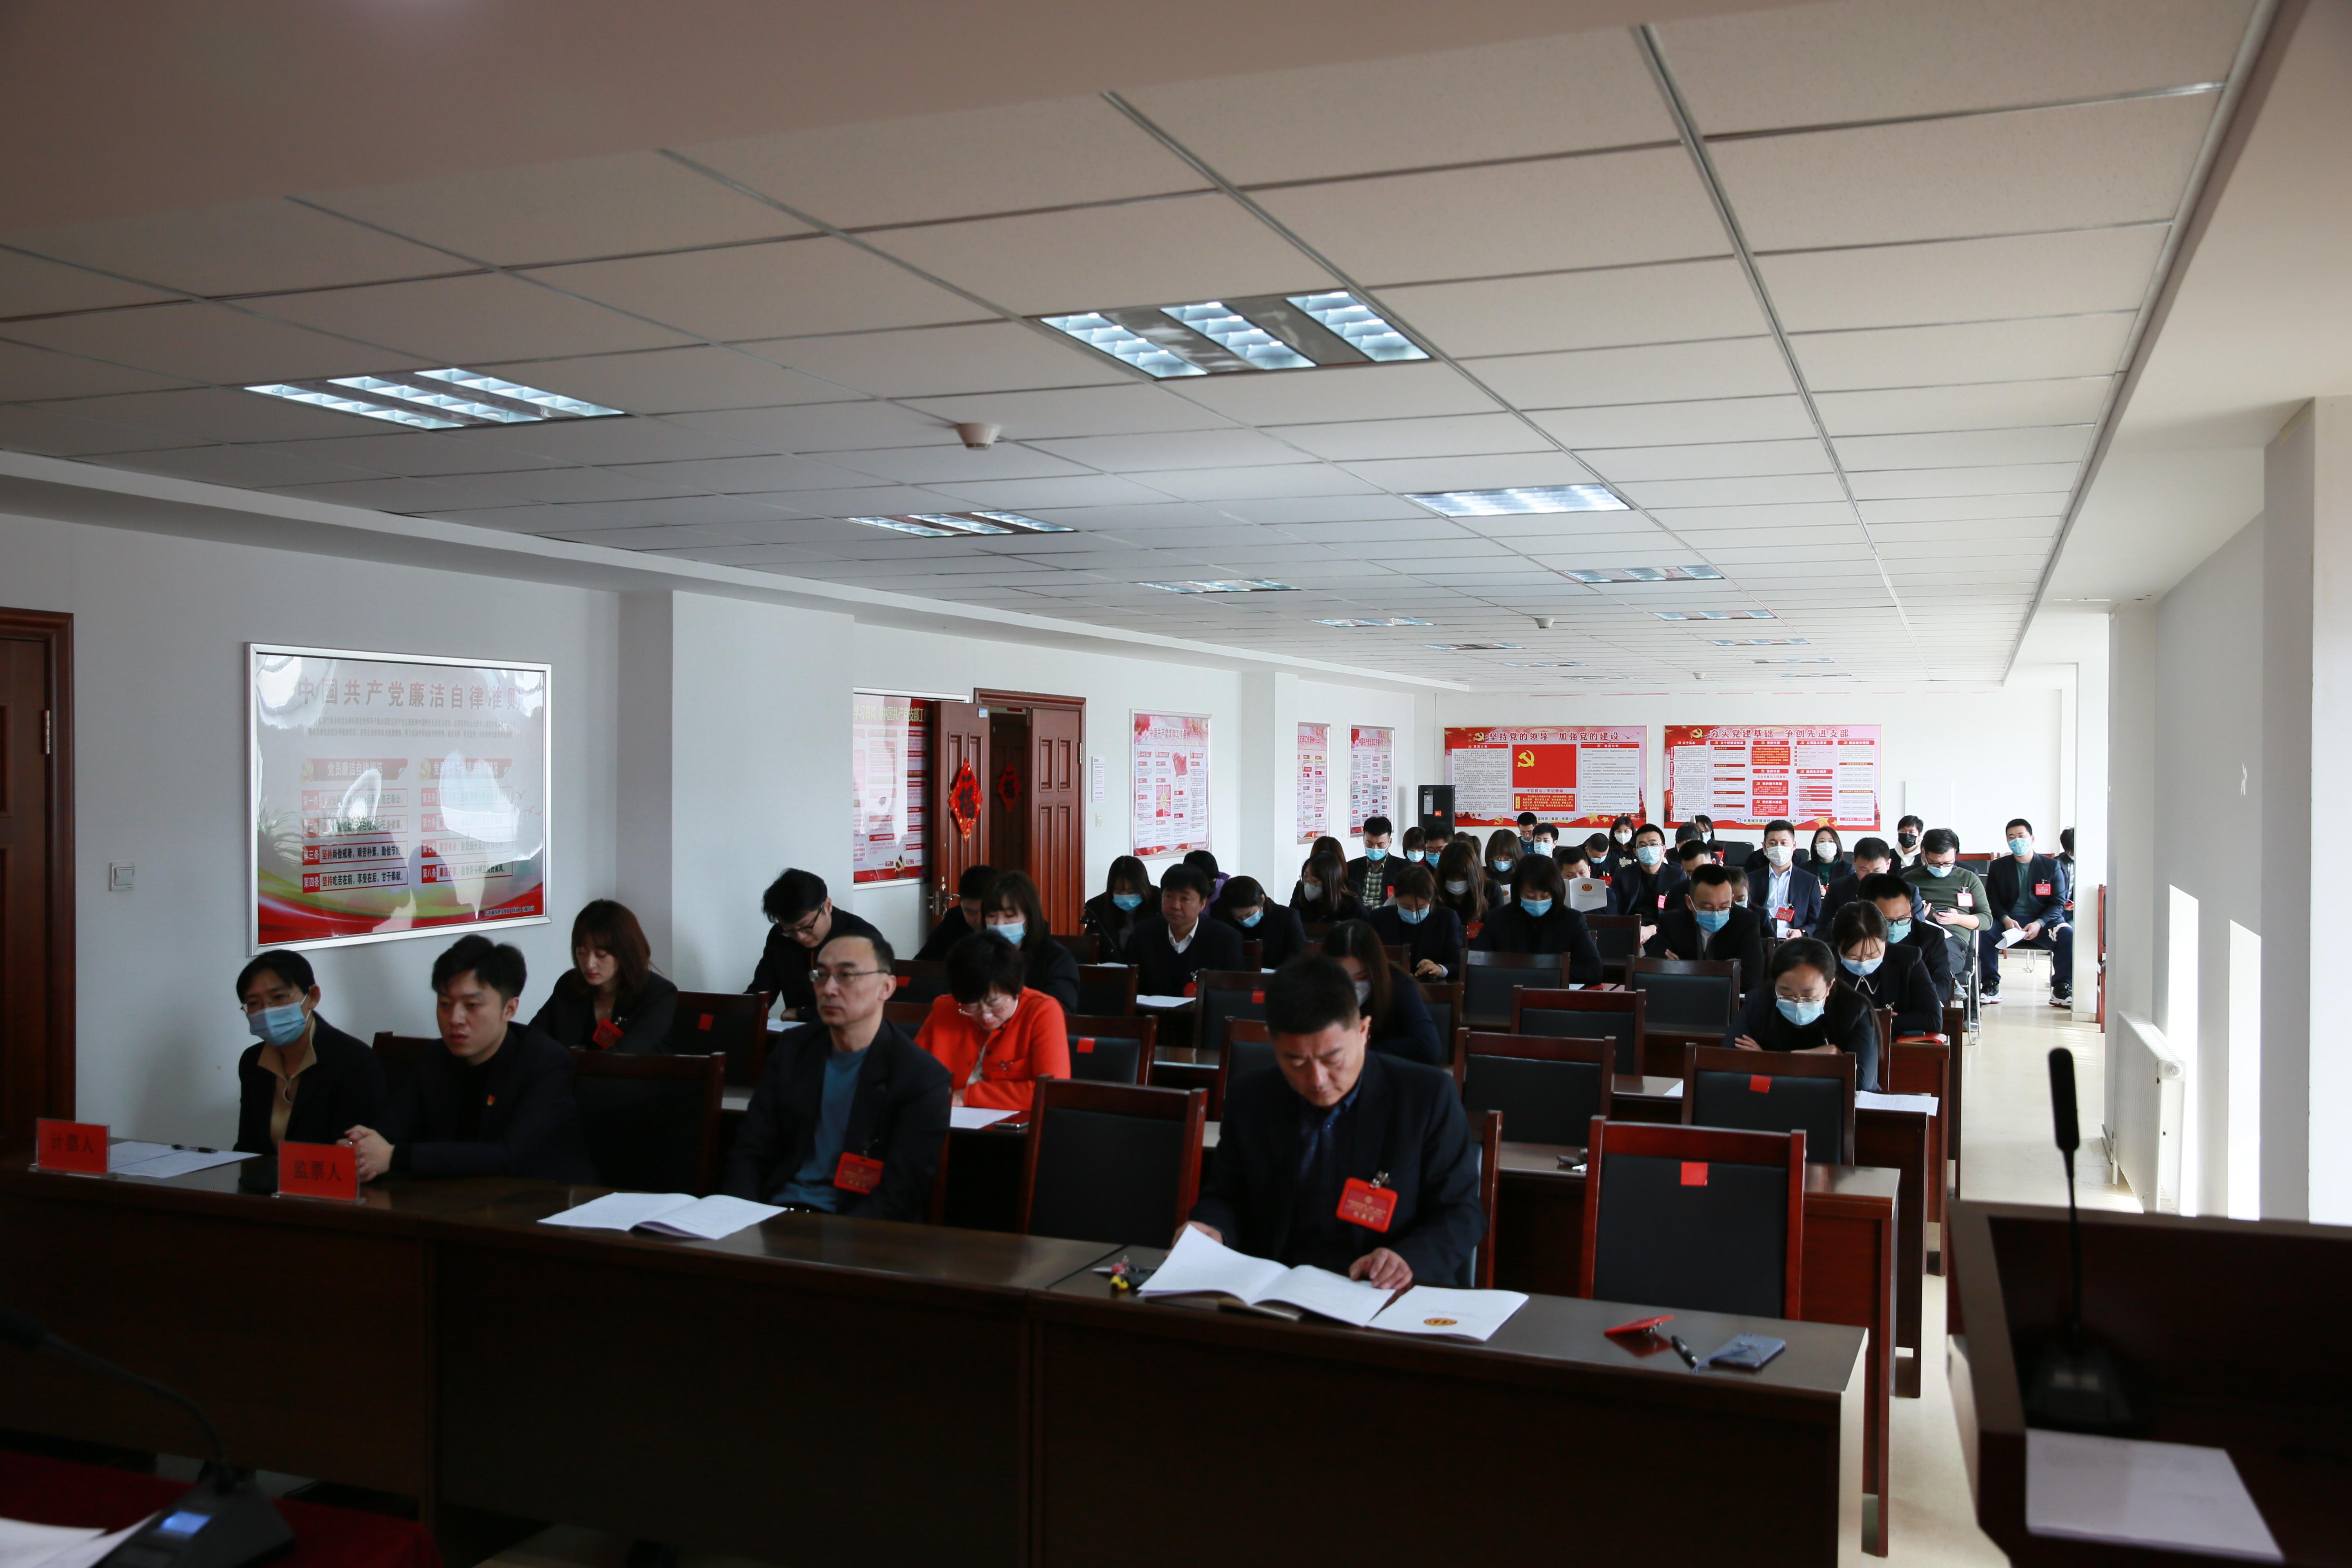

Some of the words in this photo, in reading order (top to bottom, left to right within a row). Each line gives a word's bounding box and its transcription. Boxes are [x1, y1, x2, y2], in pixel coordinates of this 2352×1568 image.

[298, 676, 520, 710] 中国共产党廉洁自律准则
[1489, 732, 1548, 741] 坚持党的领导
[1559, 732, 1619, 741] 加强党的建设
[1710, 729, 1773, 737] 夯实党建基础
[1785, 729, 1849, 737] 争创先进支部
[327, 762, 383, 776] 党员廉洁自律规范
[423, 843, 437, 853] 第七条
[303, 850, 319, 861] 第三条
[423, 869, 437, 878] 第八条
[303, 876, 320, 888] 第四条
[51, 1132, 95, 1154] 计票人
[294, 1160, 342, 1181] 监票人
